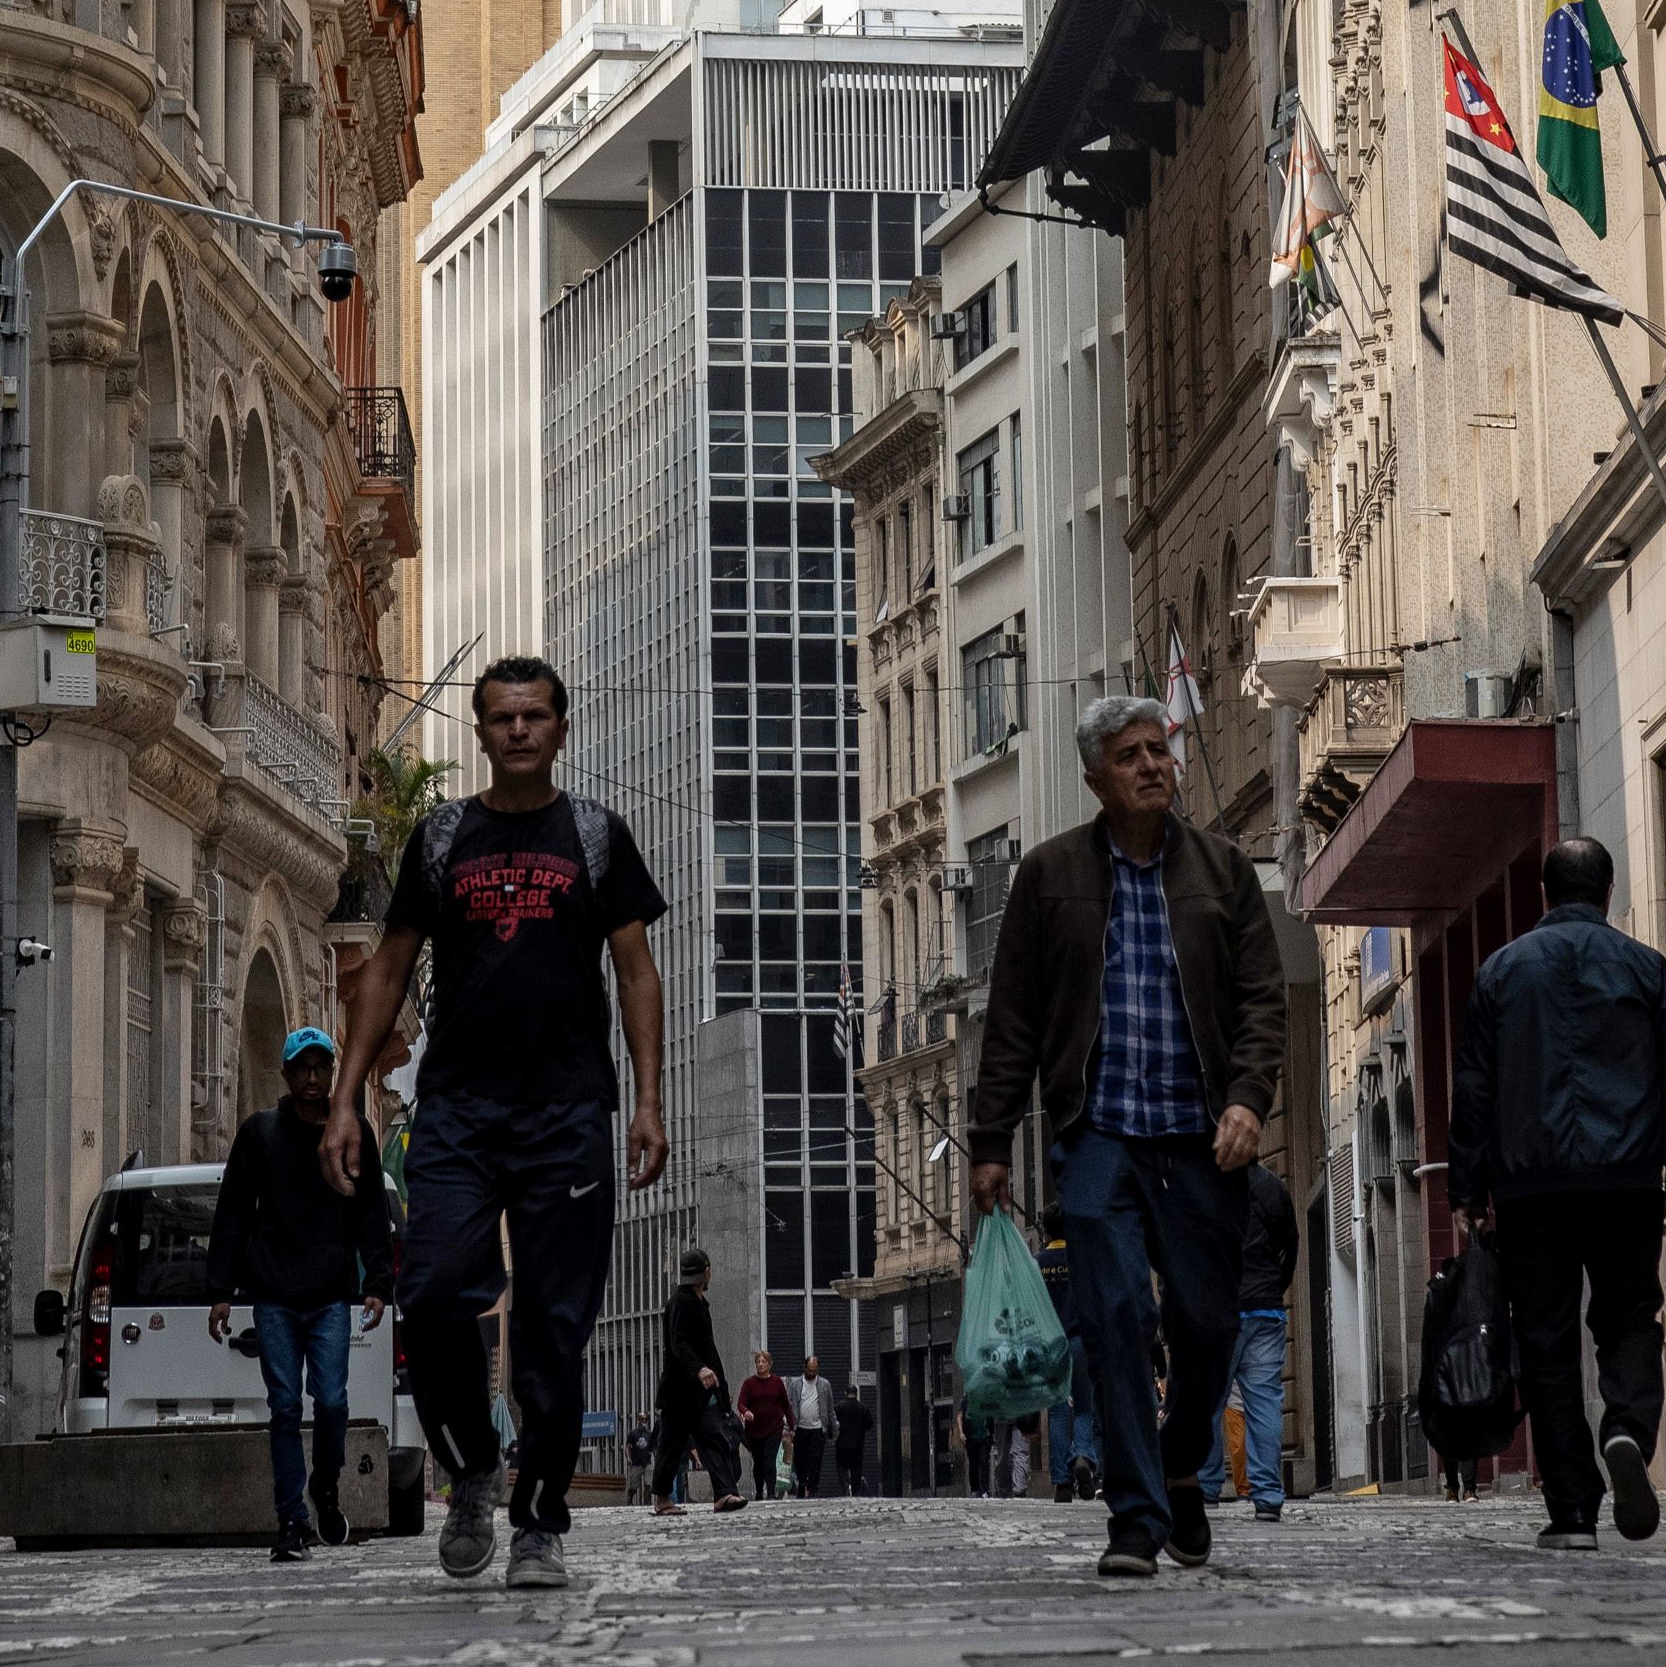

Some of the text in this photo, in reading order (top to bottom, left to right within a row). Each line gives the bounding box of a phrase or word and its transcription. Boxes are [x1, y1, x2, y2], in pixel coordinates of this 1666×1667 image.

[68, 639, 94, 652] 4690
[454, 867, 527, 899] ATHLETIC
[470, 890, 552, 909] COLLEGE
